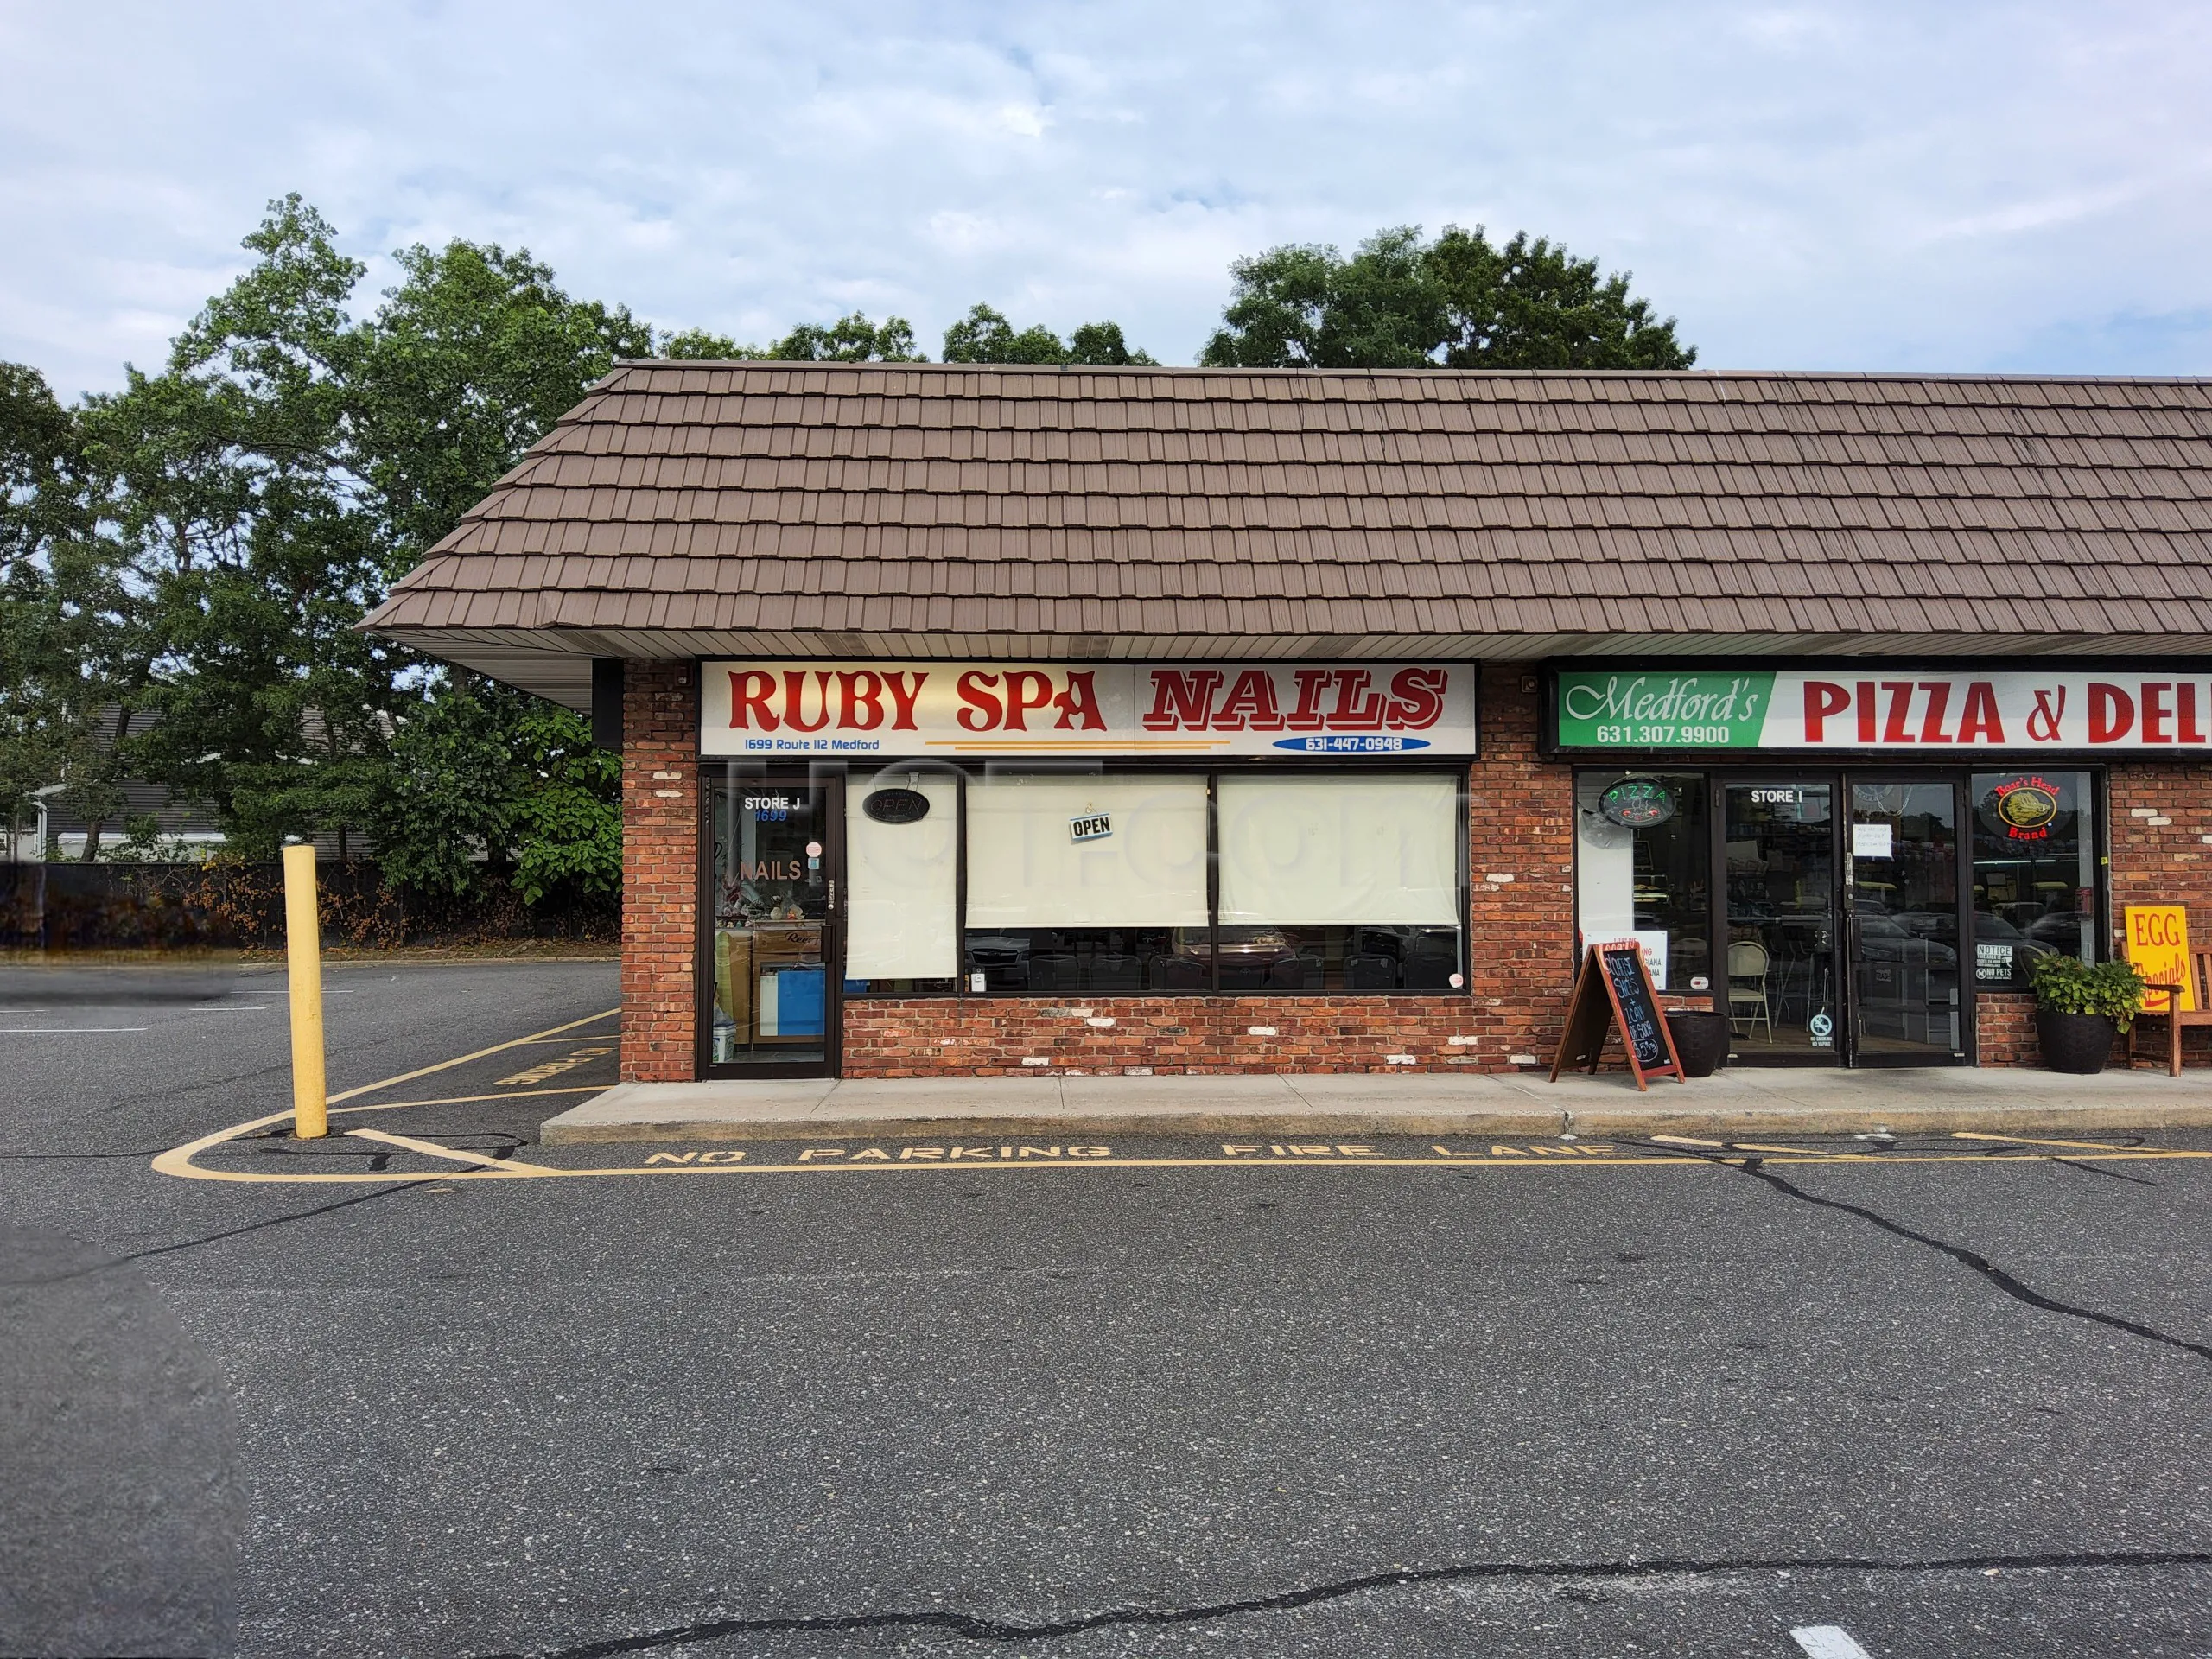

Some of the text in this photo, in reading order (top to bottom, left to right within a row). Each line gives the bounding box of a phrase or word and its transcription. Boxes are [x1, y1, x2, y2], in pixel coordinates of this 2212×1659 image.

[728, 668, 1447, 732] RUBY SPA NAILS
[1565, 675, 1758, 721] Medford's
[1803, 681, 2212, 744] PIZZA & DEL
[1306, 736, 1402, 752] 631-447-0948
[1597, 725, 1729, 744] 631.307.9900
[745, 739, 880, 750] 1699 Route 112 Medford
[1608, 785, 1667, 804] PIZZA
[2031, 776, 2060, 795] Head
[744, 797, 800, 810] STORE J
[870, 798, 922, 812] OPEN
[1751, 790, 1793, 803] STORE
[753, 810, 787, 822] 1699
[1073, 817, 1111, 837] OPEN
[2009, 827, 2048, 840] Brand
[740, 861, 801, 880] NAILS
[2133, 913, 2180, 946] EGG
[1979, 945, 2011, 955] NOTICE
[1996, 968, 2012, 976] PETS
[1637, 1020, 1654, 1039] SODA
[645, 1146, 1111, 1165] NO PARKING
[1221, 1144, 1630, 1157] FIRE LANE
